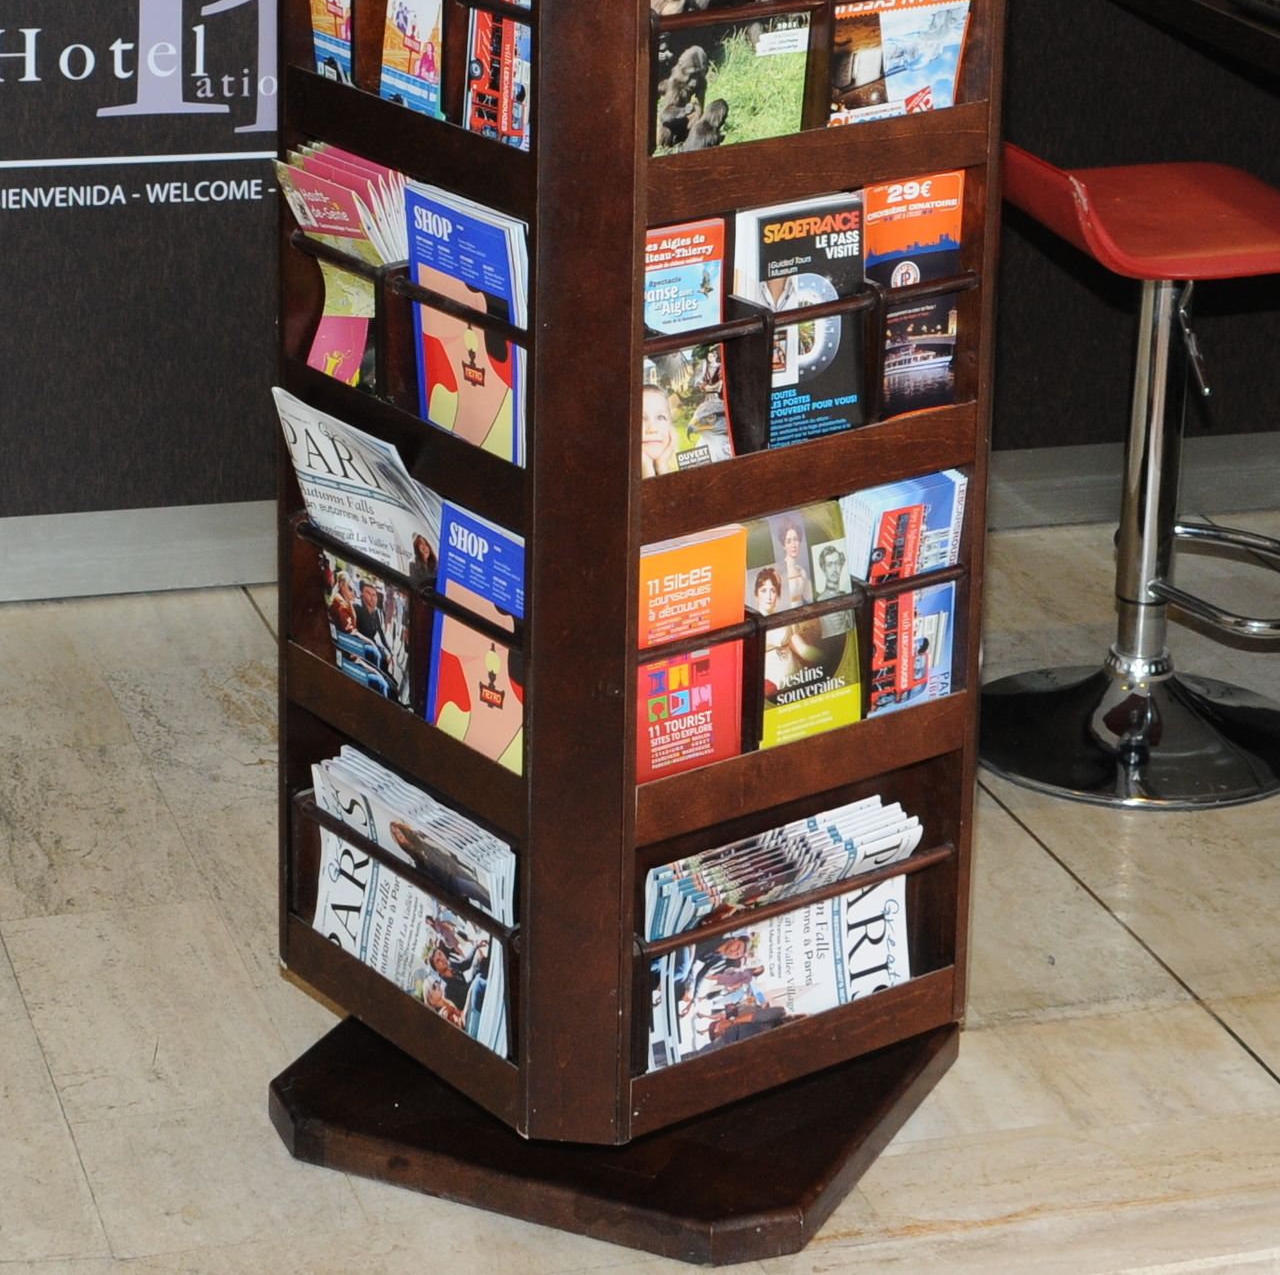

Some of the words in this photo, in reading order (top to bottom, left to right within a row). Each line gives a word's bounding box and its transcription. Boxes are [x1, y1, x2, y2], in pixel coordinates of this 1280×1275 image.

[145, 179, 263, 204] WELCOME
[886, 180, 932, 204] 29€
[413, 205, 453, 242] SHOP
[645, 243, 658, 252] es
[659, 236, 692, 250] Aigles
[692, 234, 705, 244] de
[815, 235, 828, 249] LE
[829, 230, 860, 246] PASS
[825, 243, 860, 260] VISITE
[770, 258, 794, 269] Guided
[795, 255, 812, 264] Tours
[771, 266, 798, 277] Museum
[644, 286, 678, 302] anse
[662, 298, 698, 317] Aigles
[771, 401, 782, 409] ES
[783, 394, 811, 408] PORTES
[812, 399, 833, 410] POUR
[677, 447, 709, 463] OUVERT
[347, 494, 376, 516] Falls
[448, 521, 489, 562] SHOP
[647, 579, 660, 597] 11
[776, 675, 846, 706] souverains
[648, 724, 660, 739] 11
[663, 710, 713, 734] TOURIST
[651, 734, 671, 748] SITES
[670, 732, 681, 741] TO
[681, 723, 713, 738] EXPLORE
[375, 879, 392, 924] Falls
[815, 922, 830, 960] Falls
[803, 950, 815, 986] Paris
